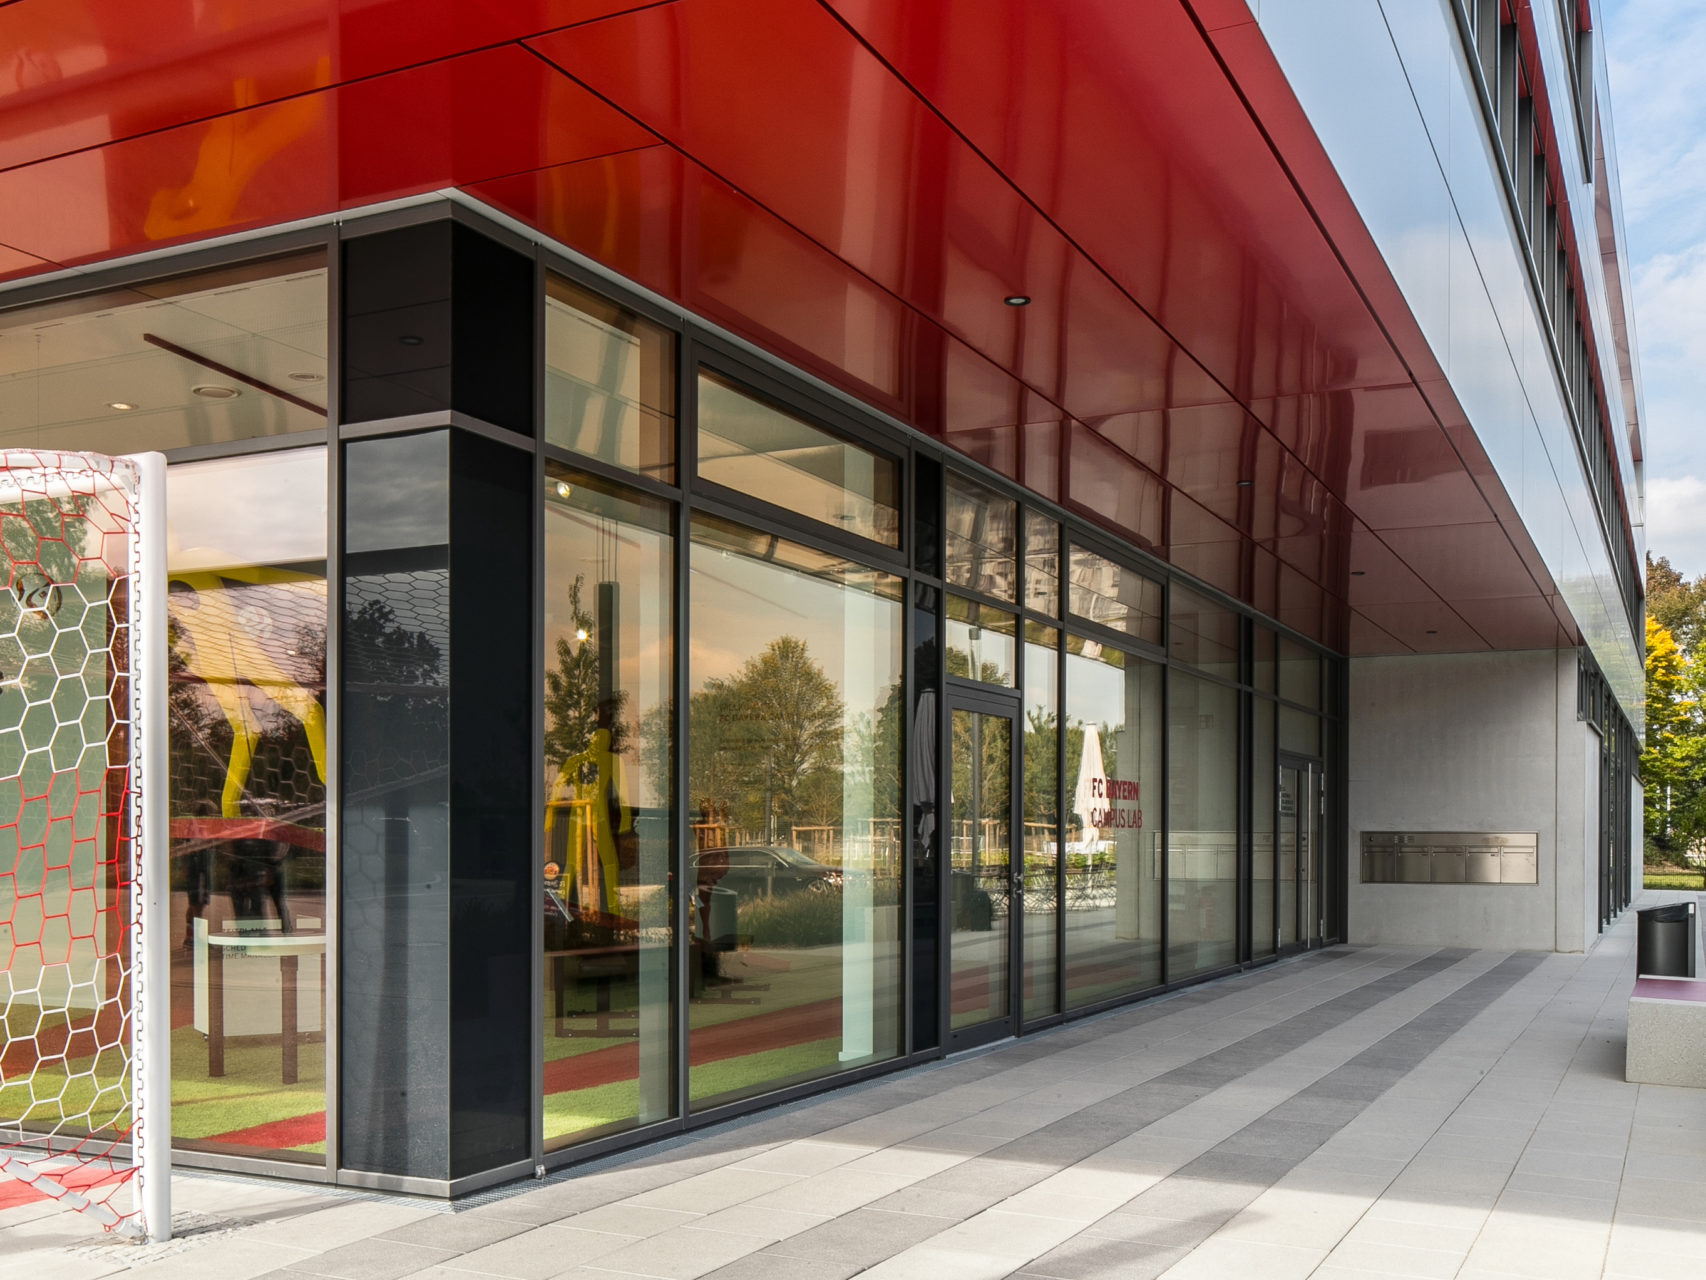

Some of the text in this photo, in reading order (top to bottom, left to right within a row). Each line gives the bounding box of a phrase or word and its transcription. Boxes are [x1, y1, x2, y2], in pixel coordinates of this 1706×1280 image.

[1092, 778, 1139, 800] FC BAYERN
[1091, 807, 1143, 829] CAMPUS LAB
